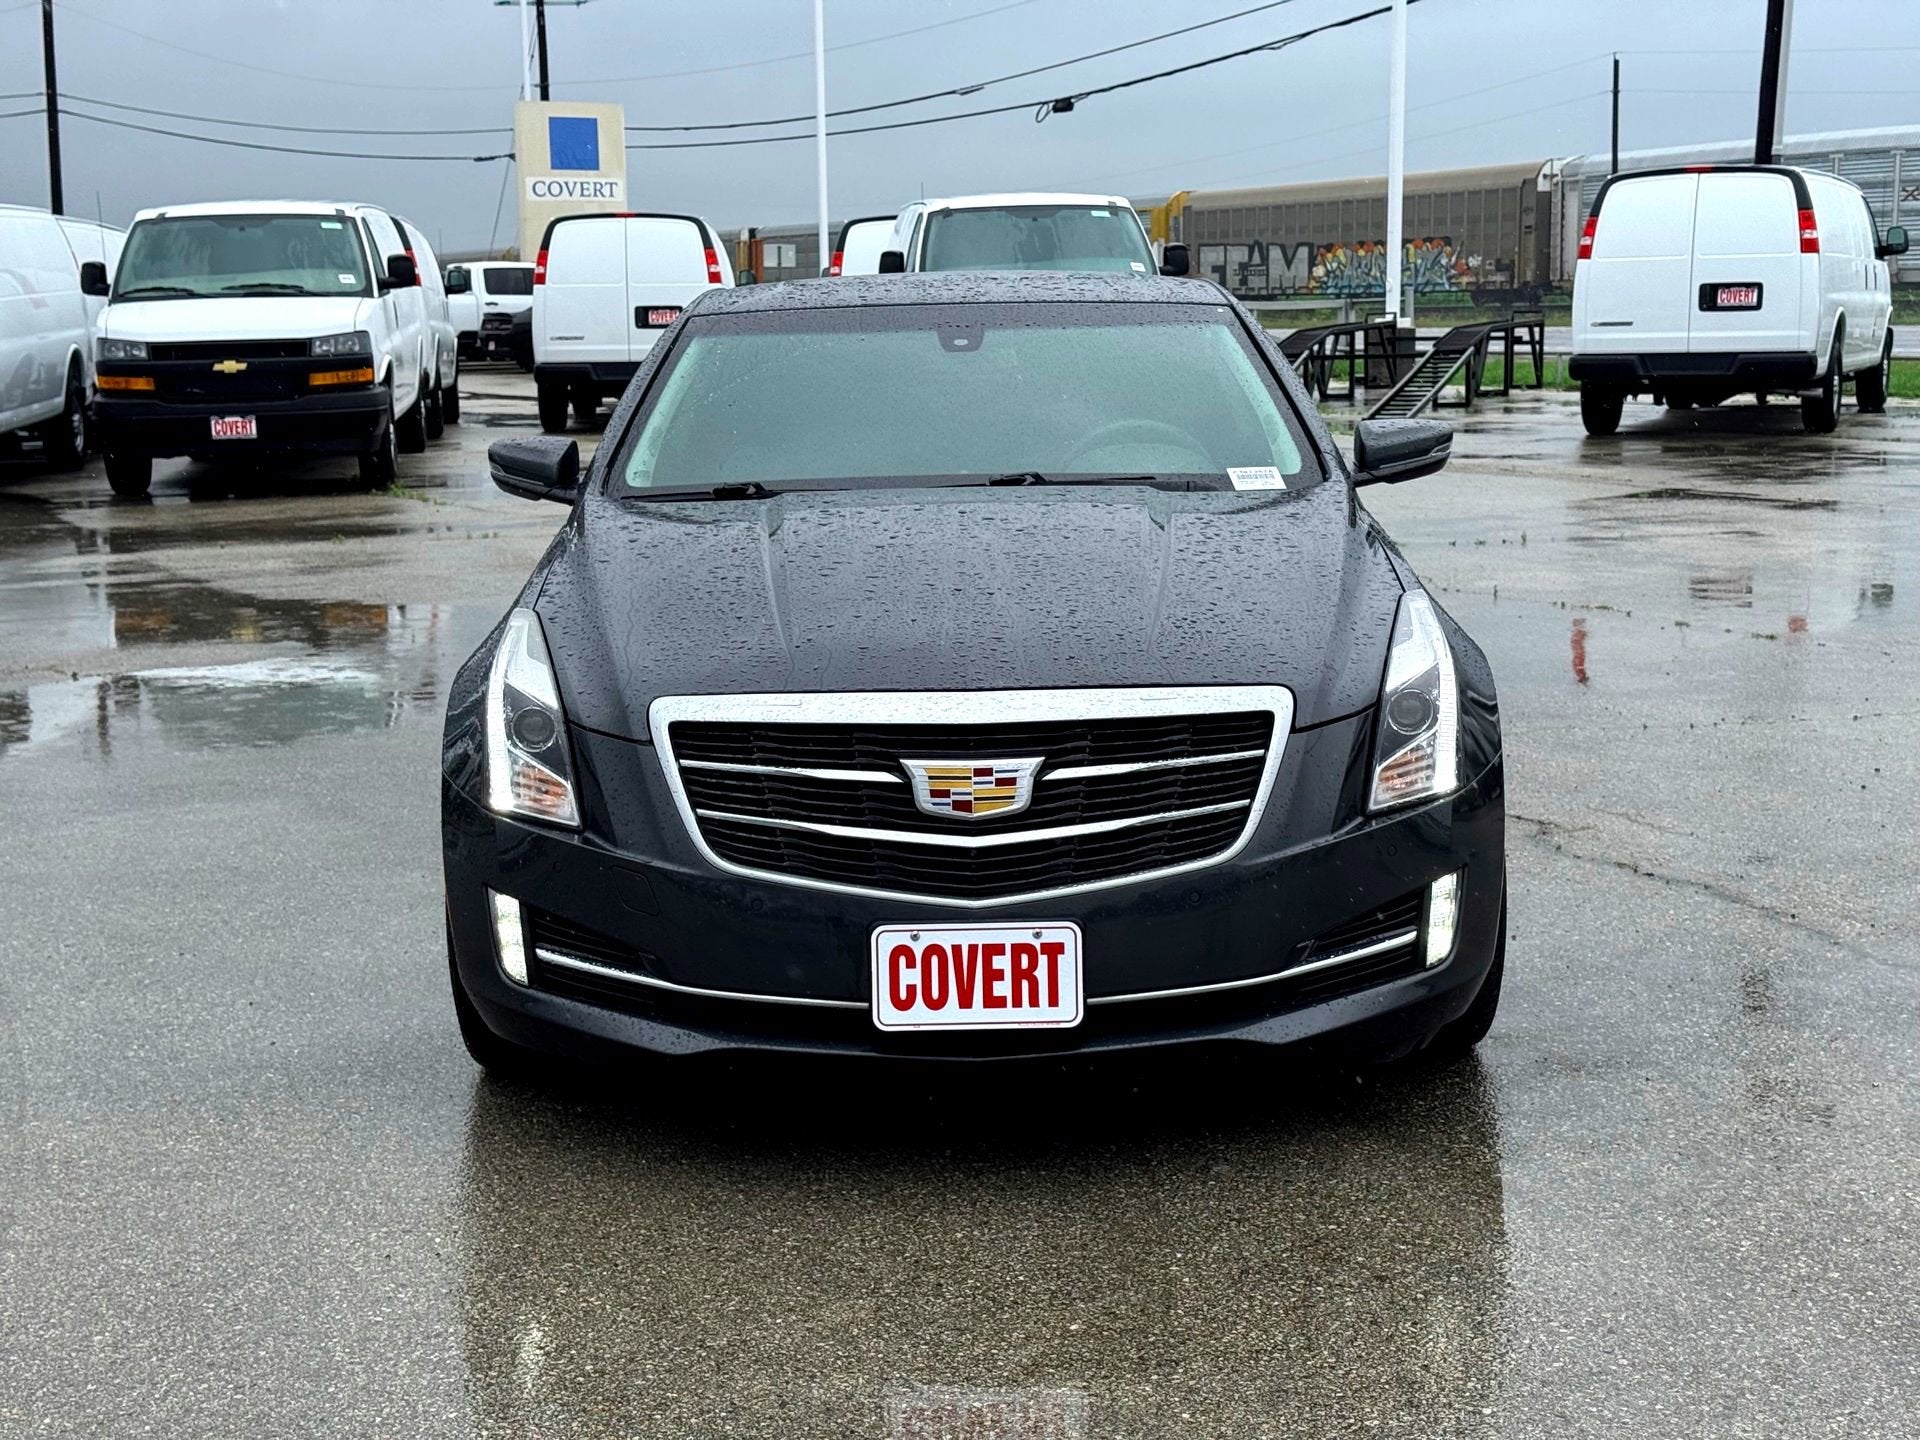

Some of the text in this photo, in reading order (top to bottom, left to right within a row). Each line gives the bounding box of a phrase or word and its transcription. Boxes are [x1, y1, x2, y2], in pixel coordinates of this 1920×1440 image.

[532, 180, 618, 198] COVERT
[1720, 288, 1755, 303] COVERT
[214, 420, 253, 436] COVERT
[888, 942, 1065, 1012] COVERT
